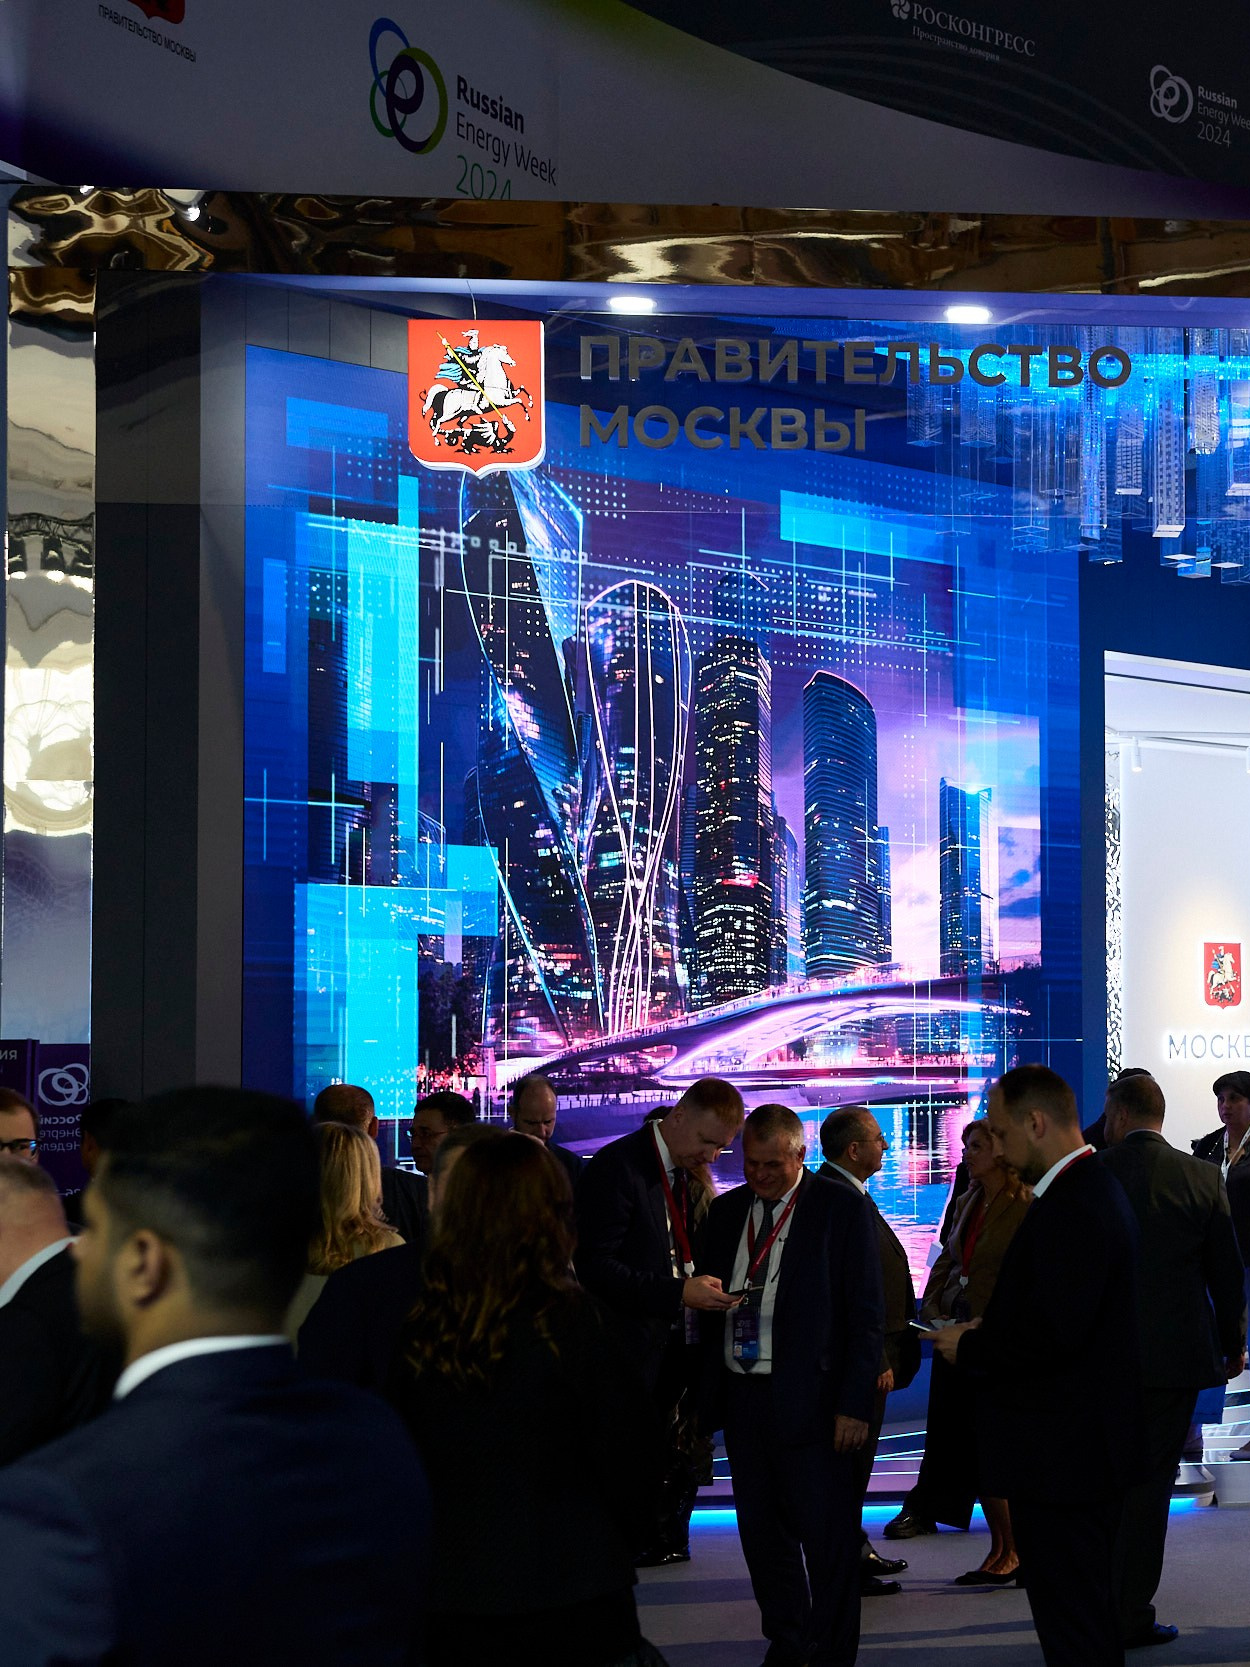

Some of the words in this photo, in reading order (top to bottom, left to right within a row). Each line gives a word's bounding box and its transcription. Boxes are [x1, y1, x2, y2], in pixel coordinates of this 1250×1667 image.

[99, 4, 162, 46] ПРАВИТЕЛЬСТВО
[164, 37, 196, 63] МОСКВЫ
[912, 3, 1036, 57] РОСКОНГРЕСС
[912, 25, 968, 51] Пространство
[457, 75, 524, 134] Russian
[1197, 85, 1237, 109] Russian
[1197, 102, 1229, 125] Energy
[457, 111, 511, 167] Energy
[514, 142, 556, 186] Week
[1197, 121, 1232, 148] 2024
[456, 155, 511, 200] 2024
[580, 334, 1132, 390] ПРАВИТЕЛЬСТВО
[580, 403, 867, 451] МОСКВЫ
